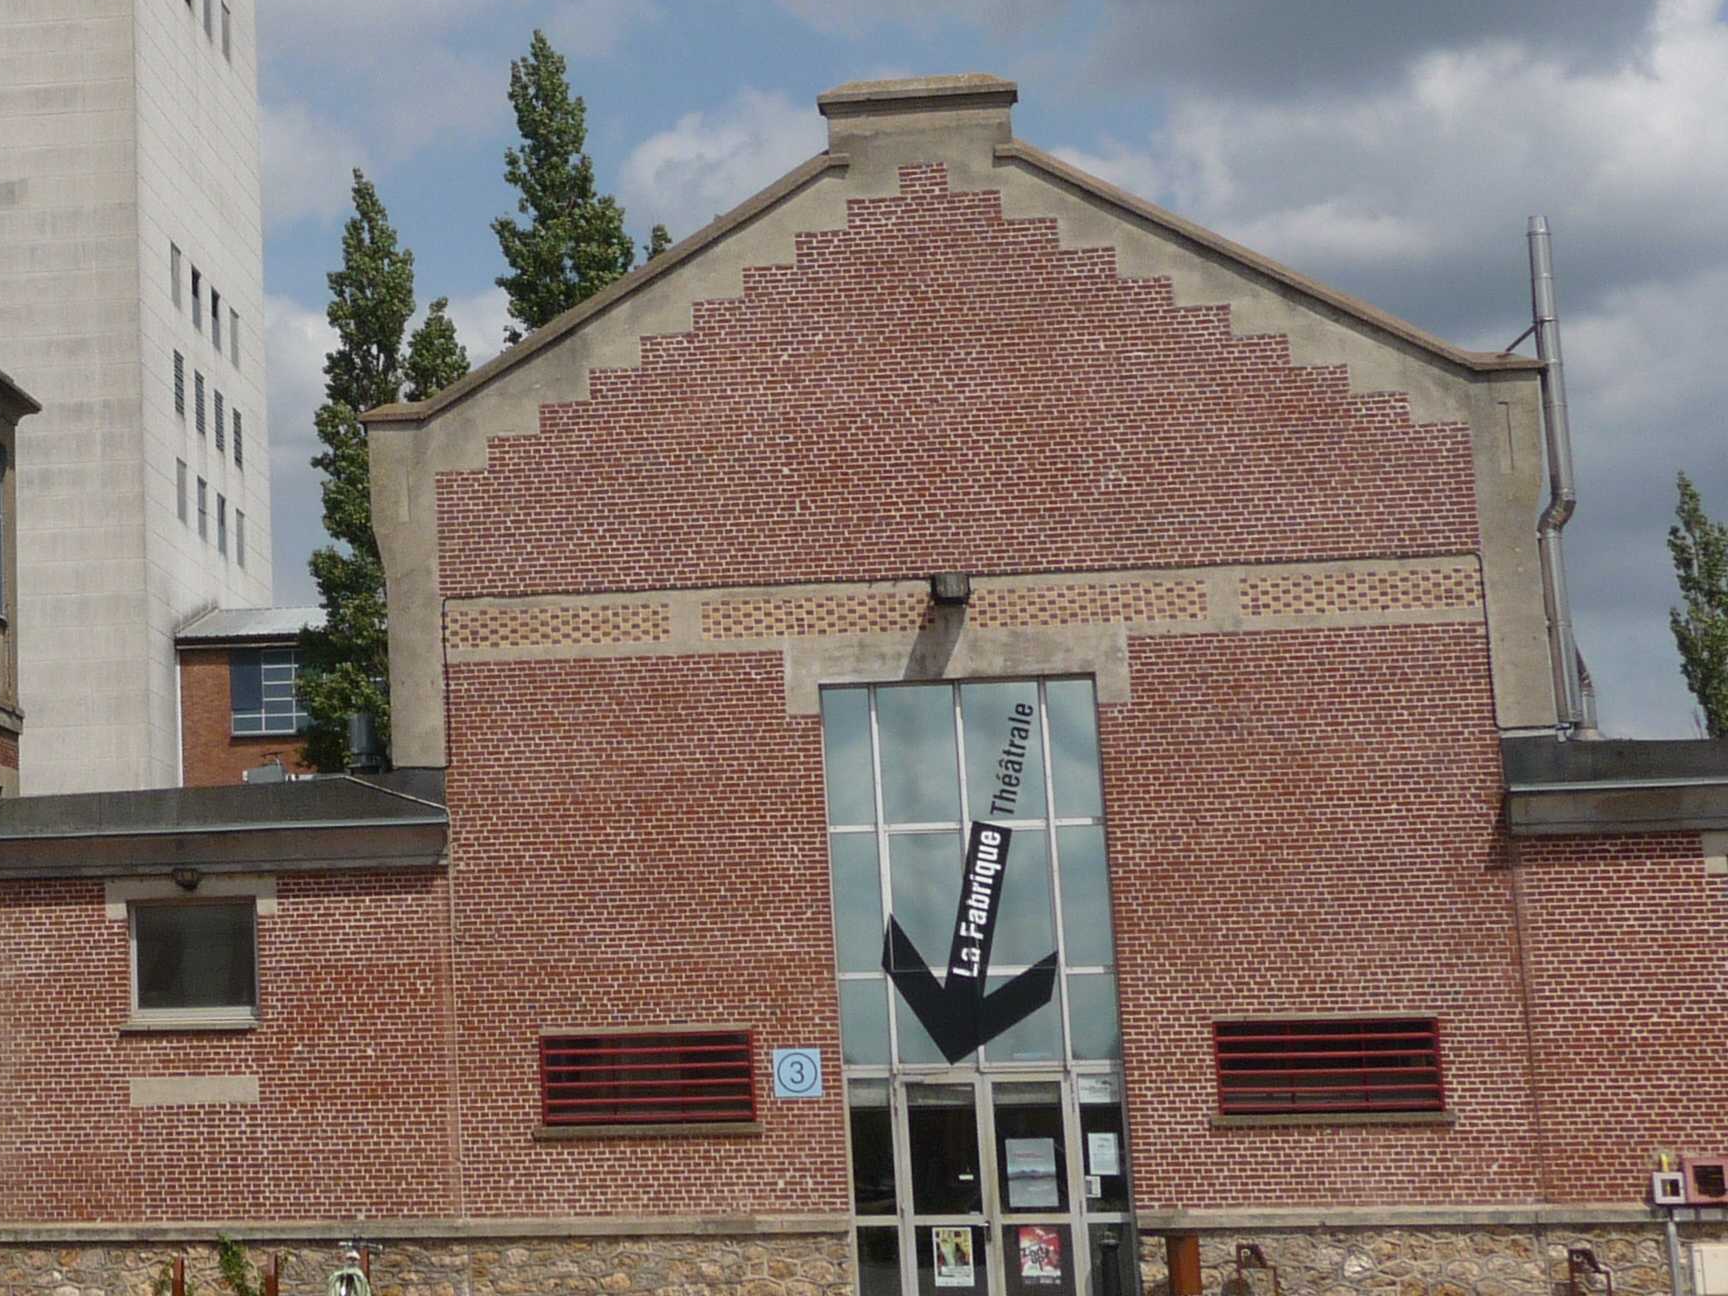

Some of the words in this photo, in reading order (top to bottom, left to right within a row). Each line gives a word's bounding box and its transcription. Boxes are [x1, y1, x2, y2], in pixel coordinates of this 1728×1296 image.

[989, 702, 1034, 816] Théâtrale
[959, 830, 1002, 940] Fabrique
[952, 946, 981, 978] La
[790, 1060, 805, 1084] 3
